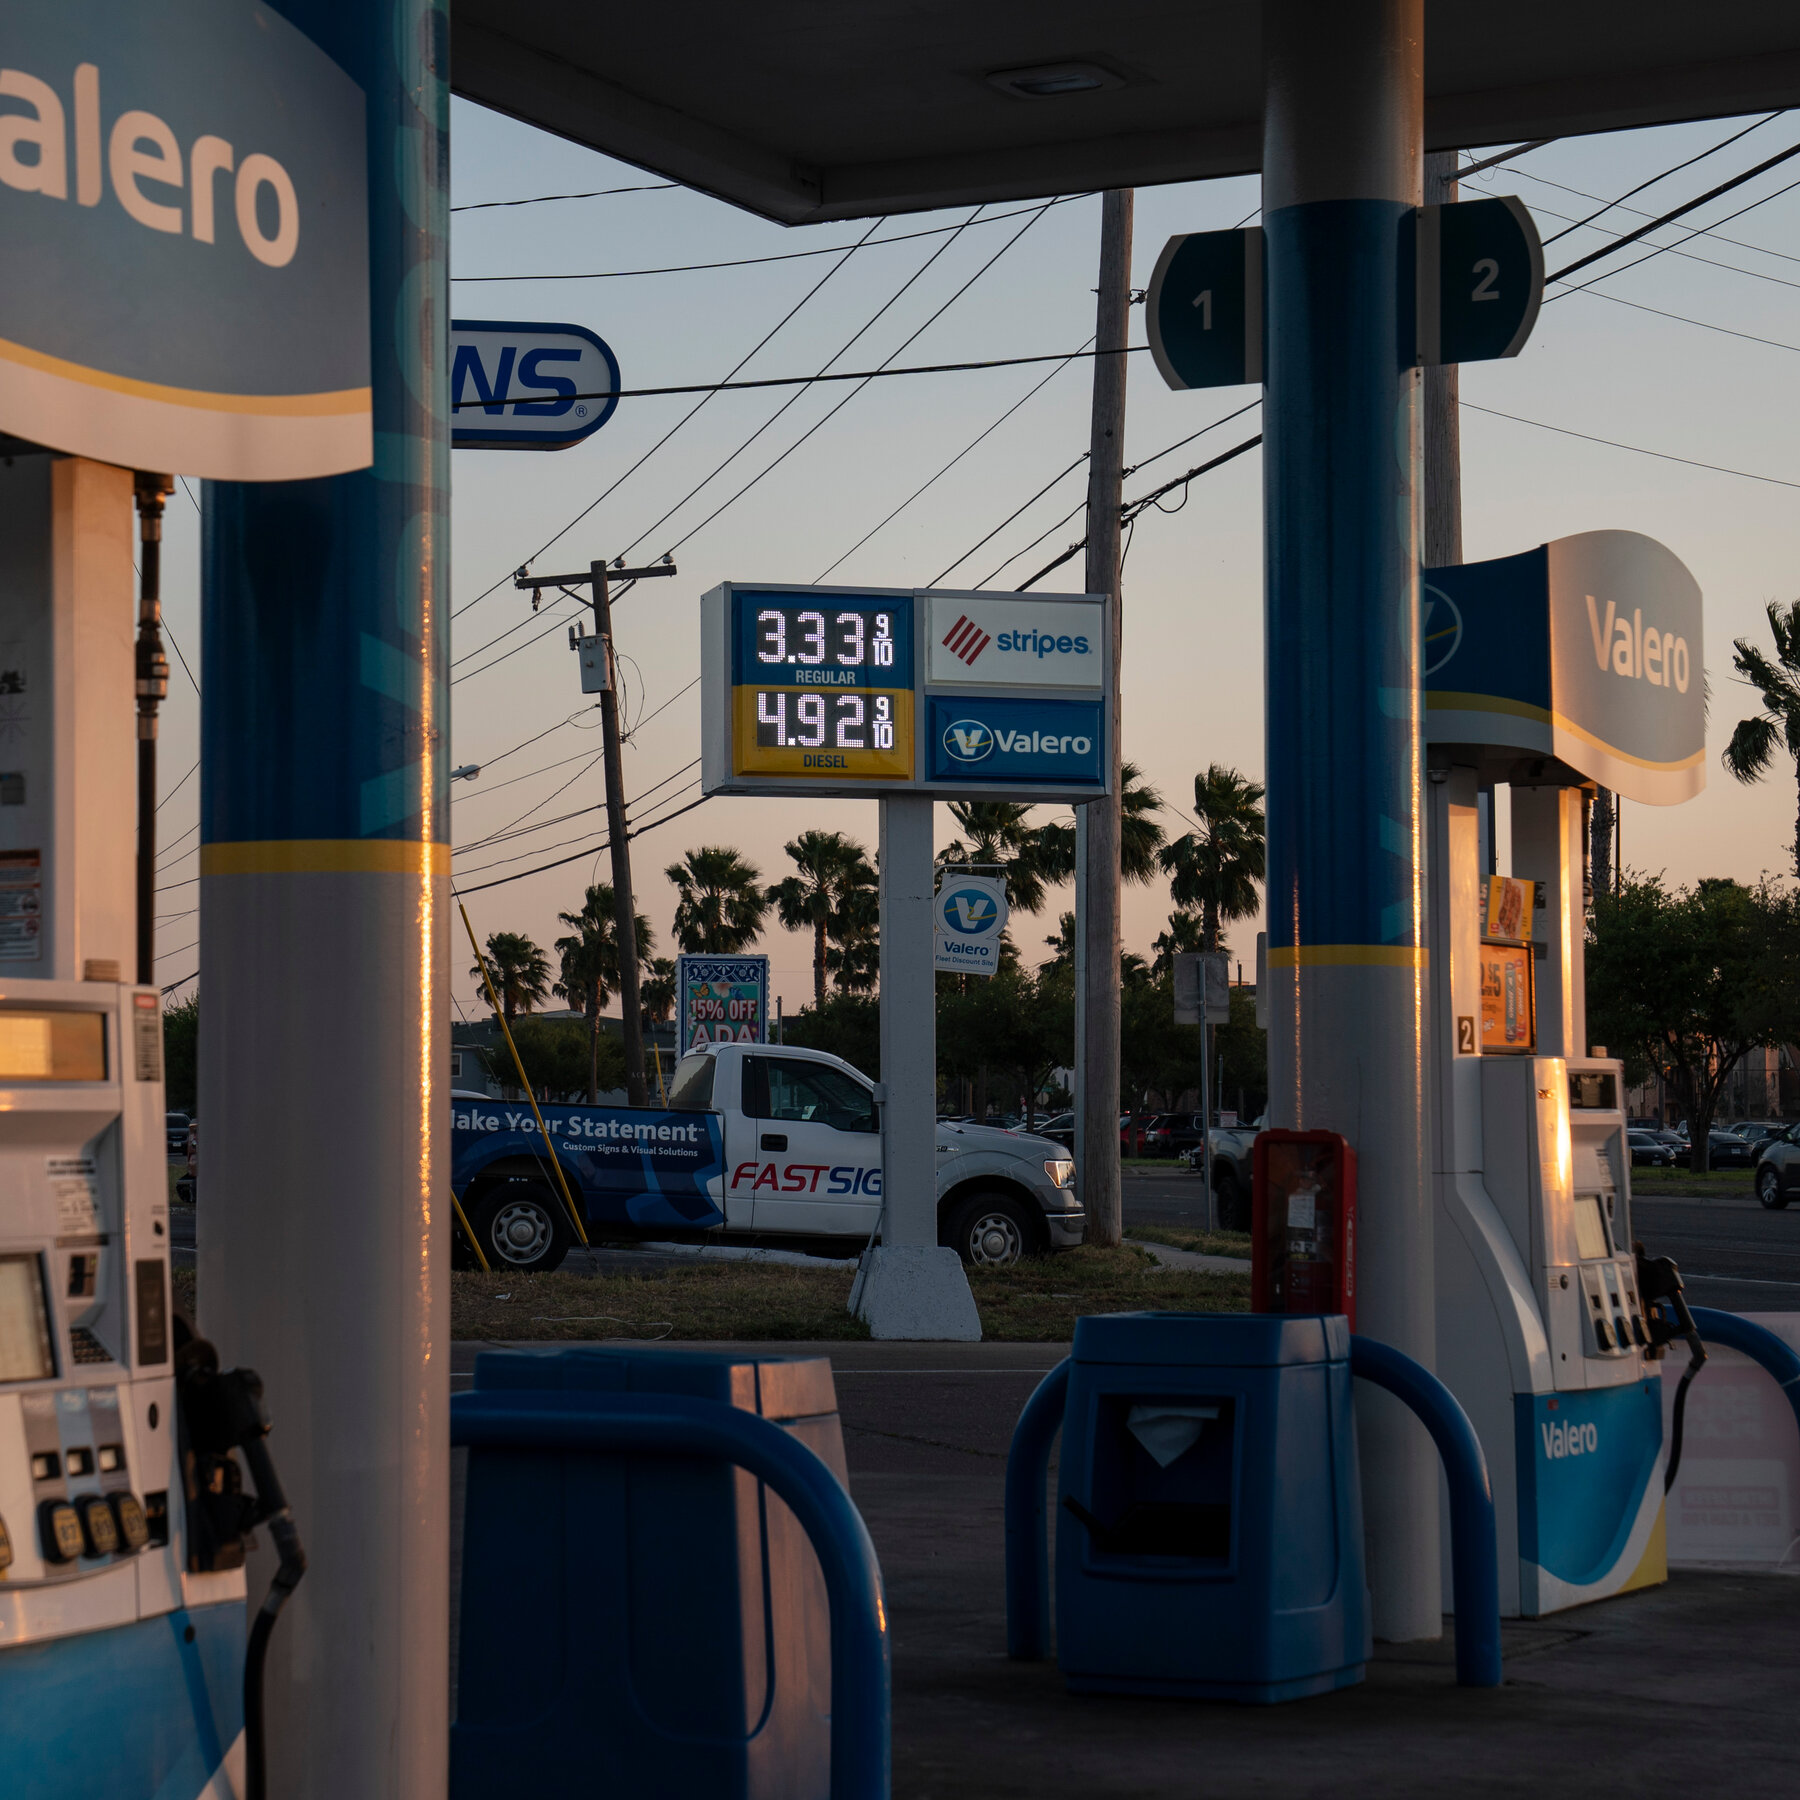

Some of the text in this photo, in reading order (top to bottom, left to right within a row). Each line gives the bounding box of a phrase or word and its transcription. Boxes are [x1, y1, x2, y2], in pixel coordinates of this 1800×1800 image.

[0, 62, 300, 269] alero
[1470, 257, 1500, 302] 2
[1191, 288, 1213, 332] 1
[451, 345, 582, 416] NS
[758, 610, 864, 665] 3.33
[997, 629, 1089, 659] stripes
[1583, 593, 1690, 695] Valero
[795, 669, 856, 685] REGULAR
[757, 692, 864, 748] 4.92
[994, 729, 1092, 755] Valero
[803, 754, 848, 768] DIESEL
[935, 954, 993, 967] Fleet Discount Site
[944, 941, 989, 956] Valero
[690, 999, 758, 1021] 15% OFF
[690, 1024, 756, 1048] ADA
[1461, 1020, 1472, 1051] 2
[451, 1108, 699, 1143] ake Your Statement
[562, 1141, 699, 1158] Custom Signs & Visual Solutions
[731, 1161, 882, 1196] FASTSIG
[1541, 1419, 1598, 1460] Valero
